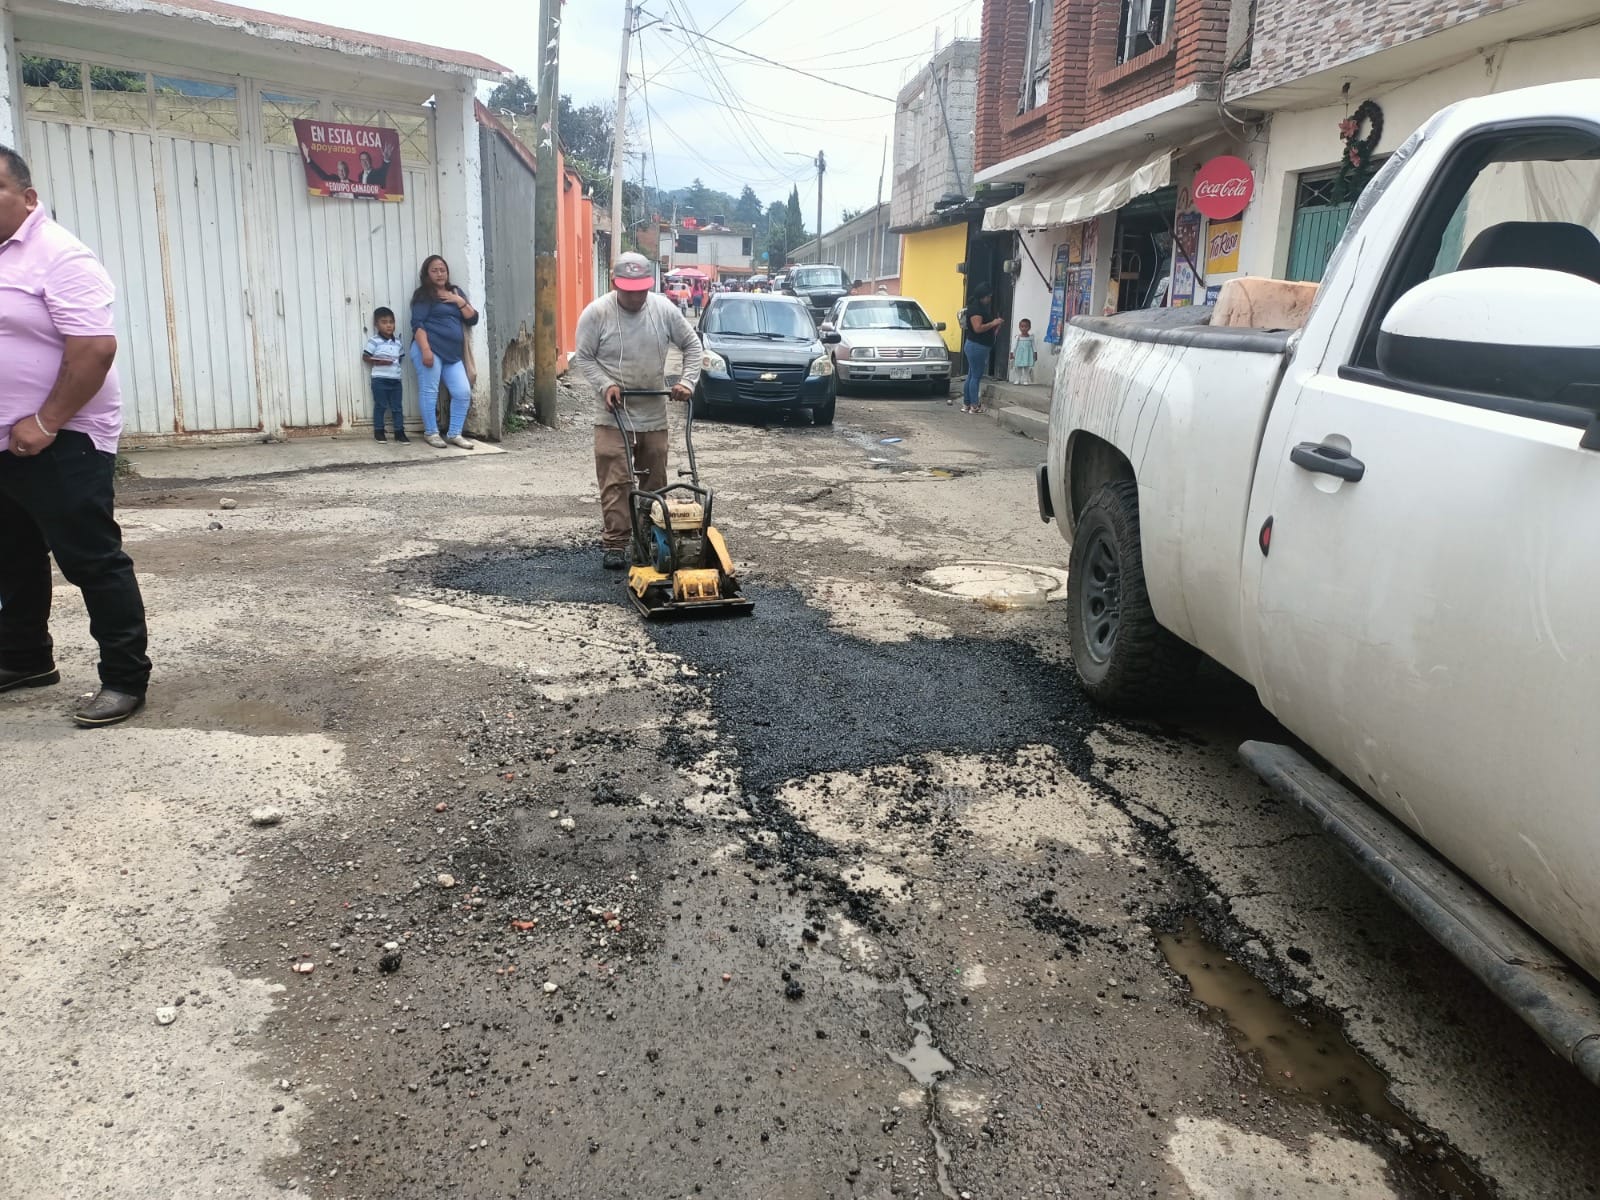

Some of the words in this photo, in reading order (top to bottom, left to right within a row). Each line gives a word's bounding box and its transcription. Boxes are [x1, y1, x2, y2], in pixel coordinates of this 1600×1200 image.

[311, 126, 325, 142] EN
[328, 128, 354, 145] ESTA
[356, 131, 382, 148] CASA
[311, 143, 357, 153] apoyamos
[329, 182, 350, 192] EQUIPO
[350, 184, 379, 194] GANADOR
[1195, 178, 1249, 198] Coca-Cola
[1219, 232, 1239, 254] Rosa
